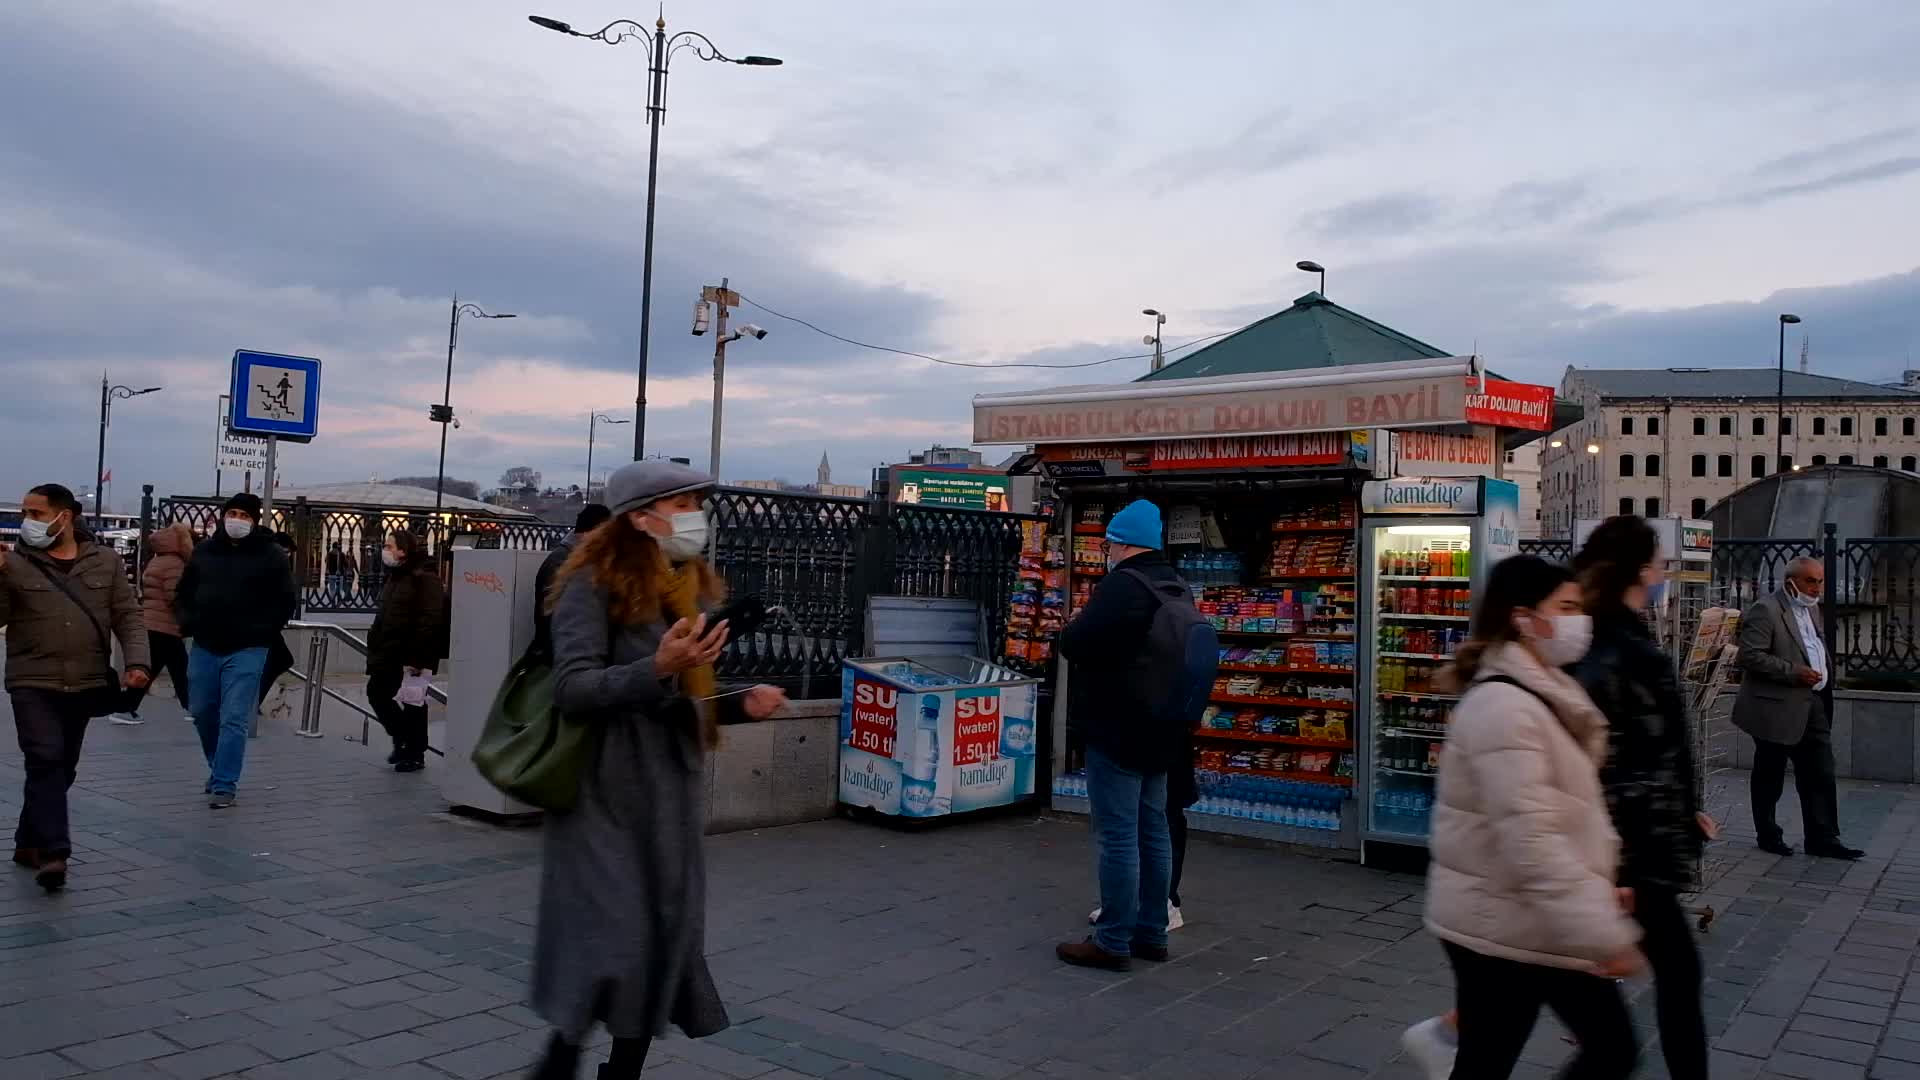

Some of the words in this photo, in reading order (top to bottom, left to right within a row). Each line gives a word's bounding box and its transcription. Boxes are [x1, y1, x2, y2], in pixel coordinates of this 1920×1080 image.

[1214, 399, 1327, 428] DOLUM
[1346, 384, 1441, 424] BAYİİ
[1465, 394, 1489, 409] KART
[1490, 396, 1521, 414] DOLUM
[1254, 433, 1298, 457] DOLUM
[1448, 433, 1456, 463] &
[229, 458, 243, 467] ALT
[1384, 482, 1463, 509] hamidiye
[855, 683, 898, 709] SU
[957, 696, 998, 718] SU
[855, 707, 895, 726] (water)
[850, 728, 879, 750] 1.50
[958, 720, 996, 739] (water)
[954, 741, 983, 762] 1.50
[844, 763, 895, 800] hamidiye
[960, 762, 1008, 788] hamidiye
